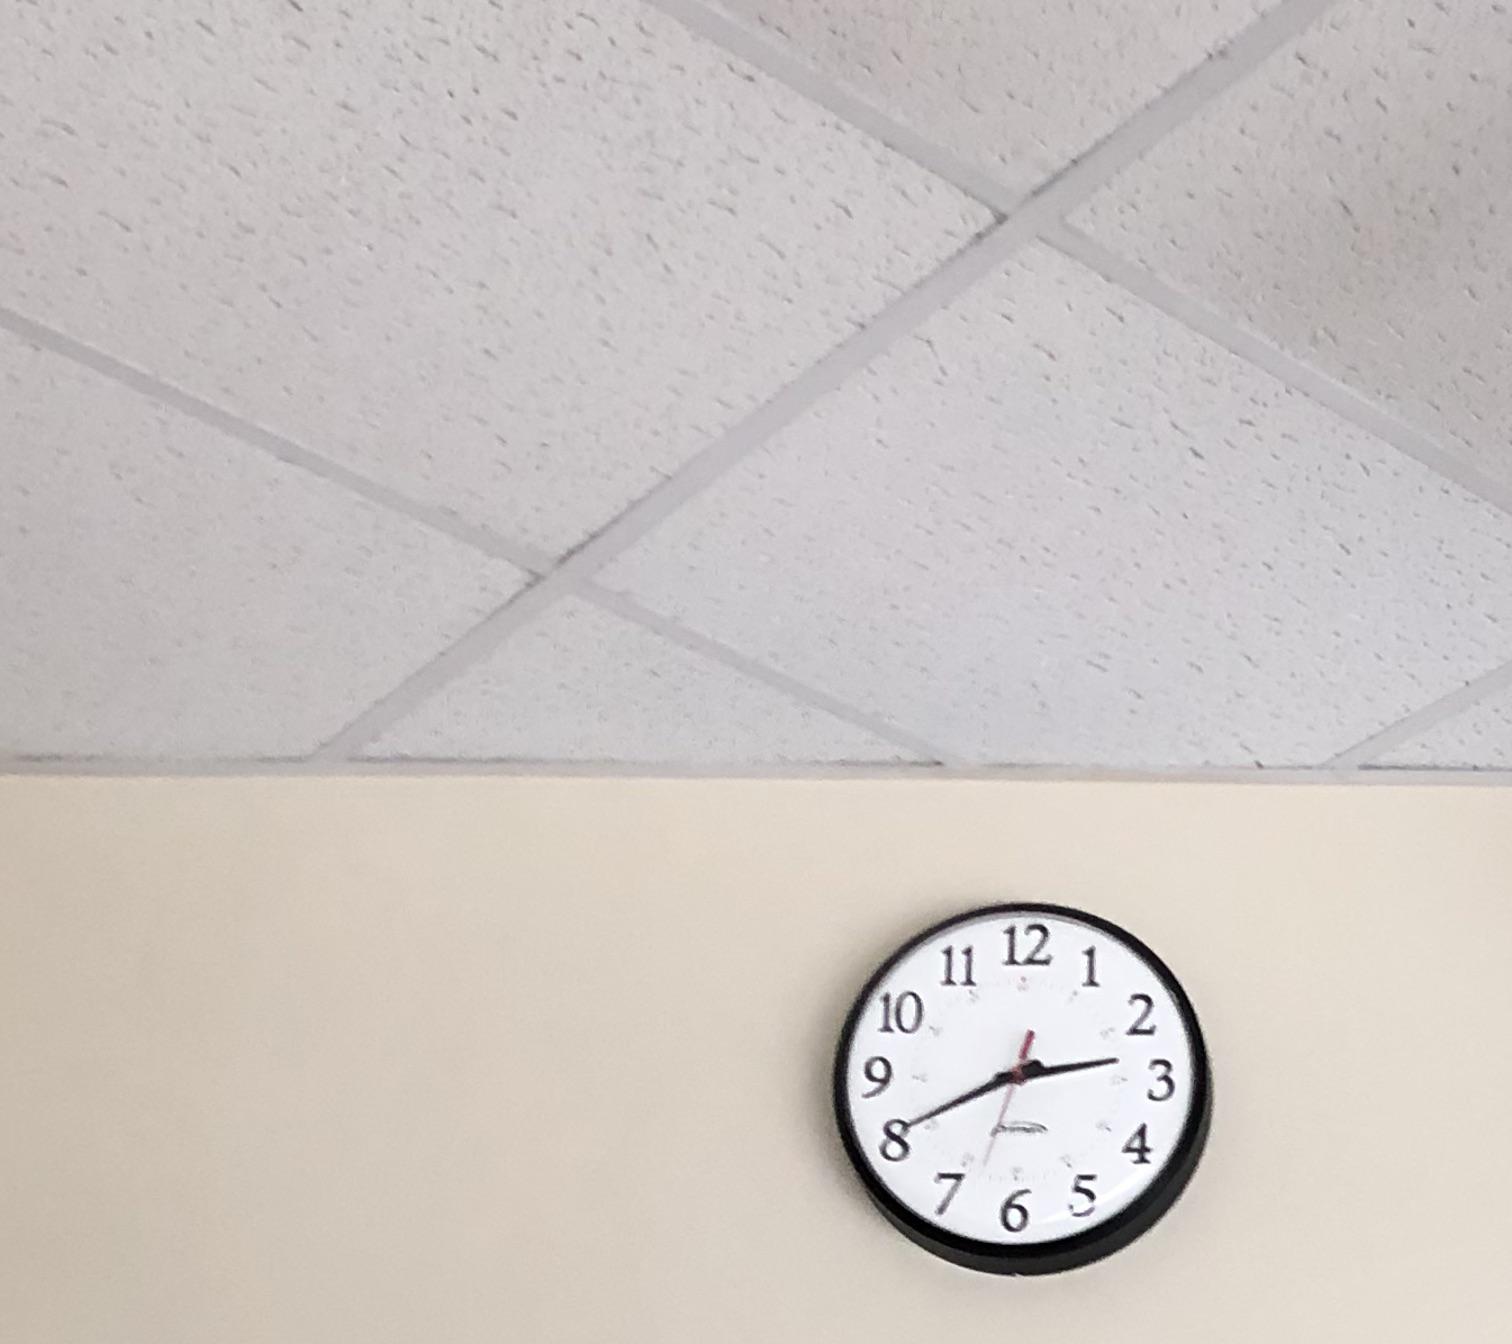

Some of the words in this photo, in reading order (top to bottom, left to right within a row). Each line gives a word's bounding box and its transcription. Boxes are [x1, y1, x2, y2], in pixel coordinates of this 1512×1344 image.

[941, 946, 976, 986] 11
[1003, 924, 1052, 966] 12
[1082, 946, 1100, 987] 1
[878, 991, 923, 1033] 10
[1126, 994, 1156, 1036] 2
[862, 1056, 892, 1098] 9
[1147, 1059, 1175, 1101] 3
[879, 1119, 910, 1162] 8
[1122, 1123, 1152, 1164] 4
[934, 1173, 965, 1214] 7
[1000, 1189, 1031, 1232] 6
[1069, 1174, 1097, 1216] 5
